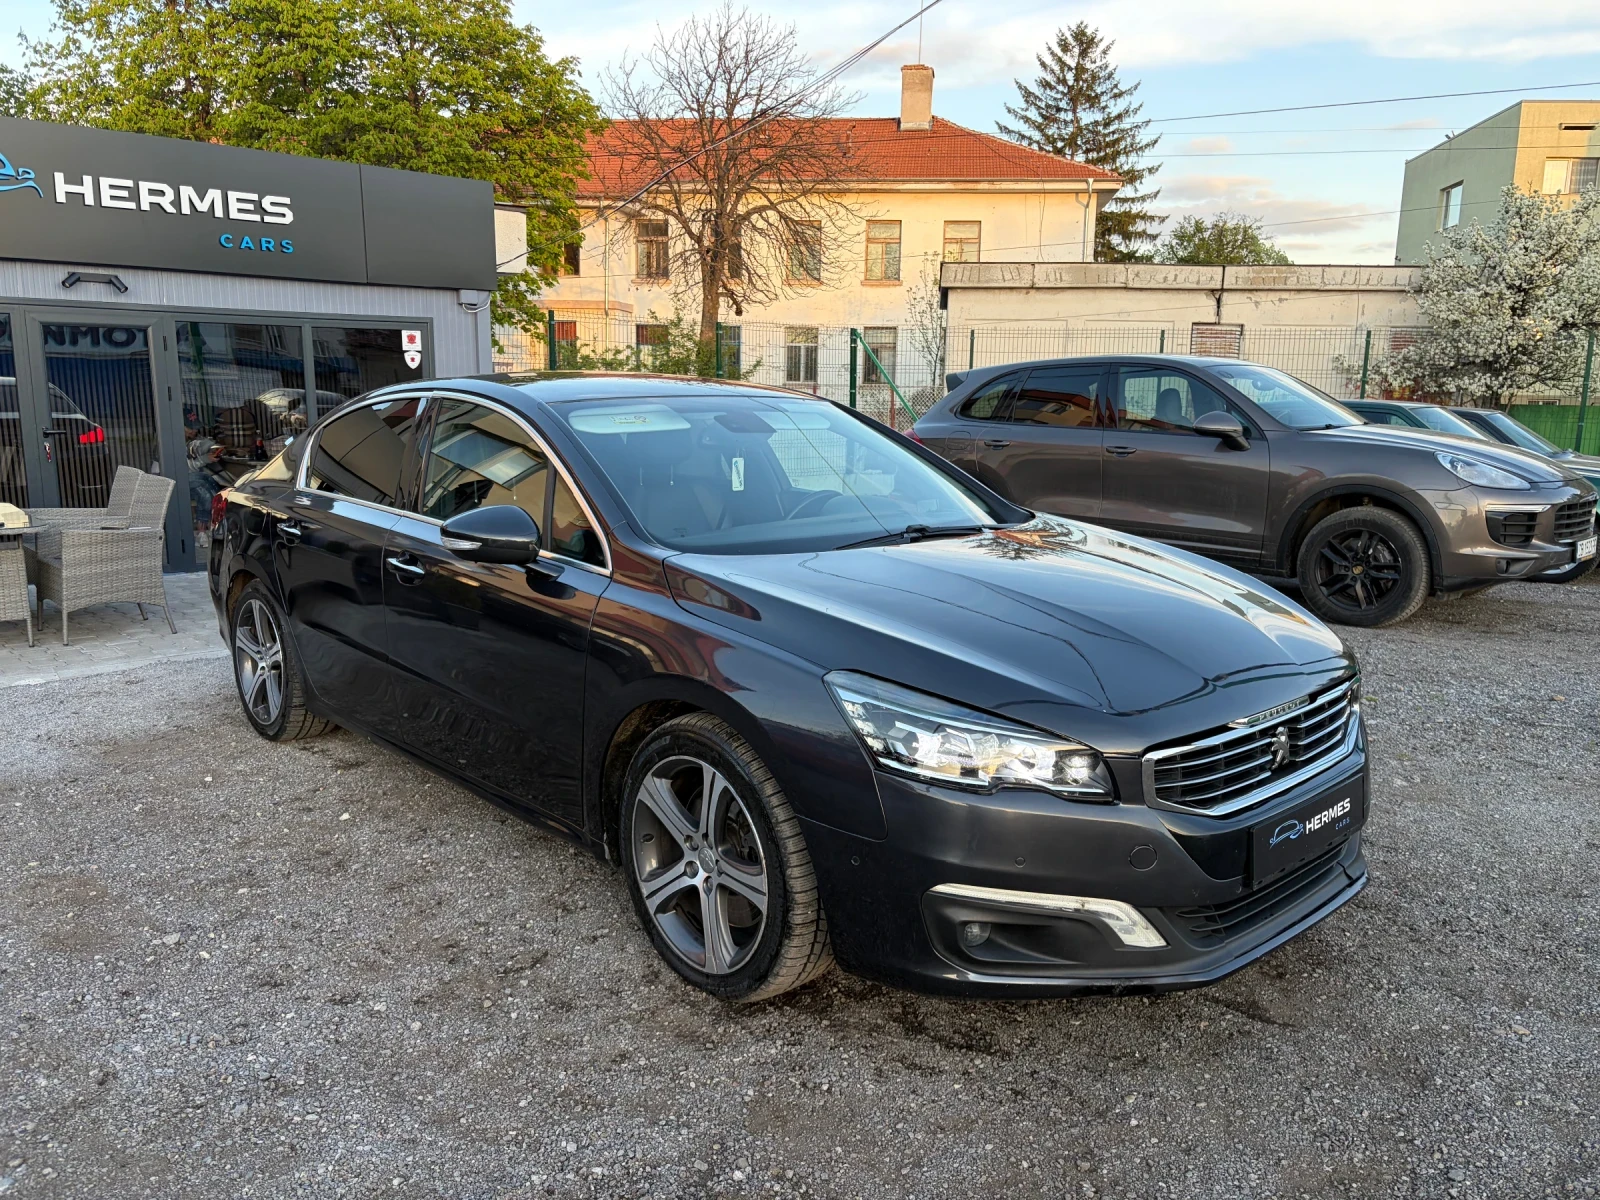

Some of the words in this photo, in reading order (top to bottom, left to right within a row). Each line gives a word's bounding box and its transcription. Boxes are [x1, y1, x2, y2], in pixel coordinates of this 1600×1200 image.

[53, 171, 294, 225] HERMES
[219, 233, 294, 254] CARS
[1306, 798, 1351, 834] HERMES
[1335, 817, 1350, 830] CARS
